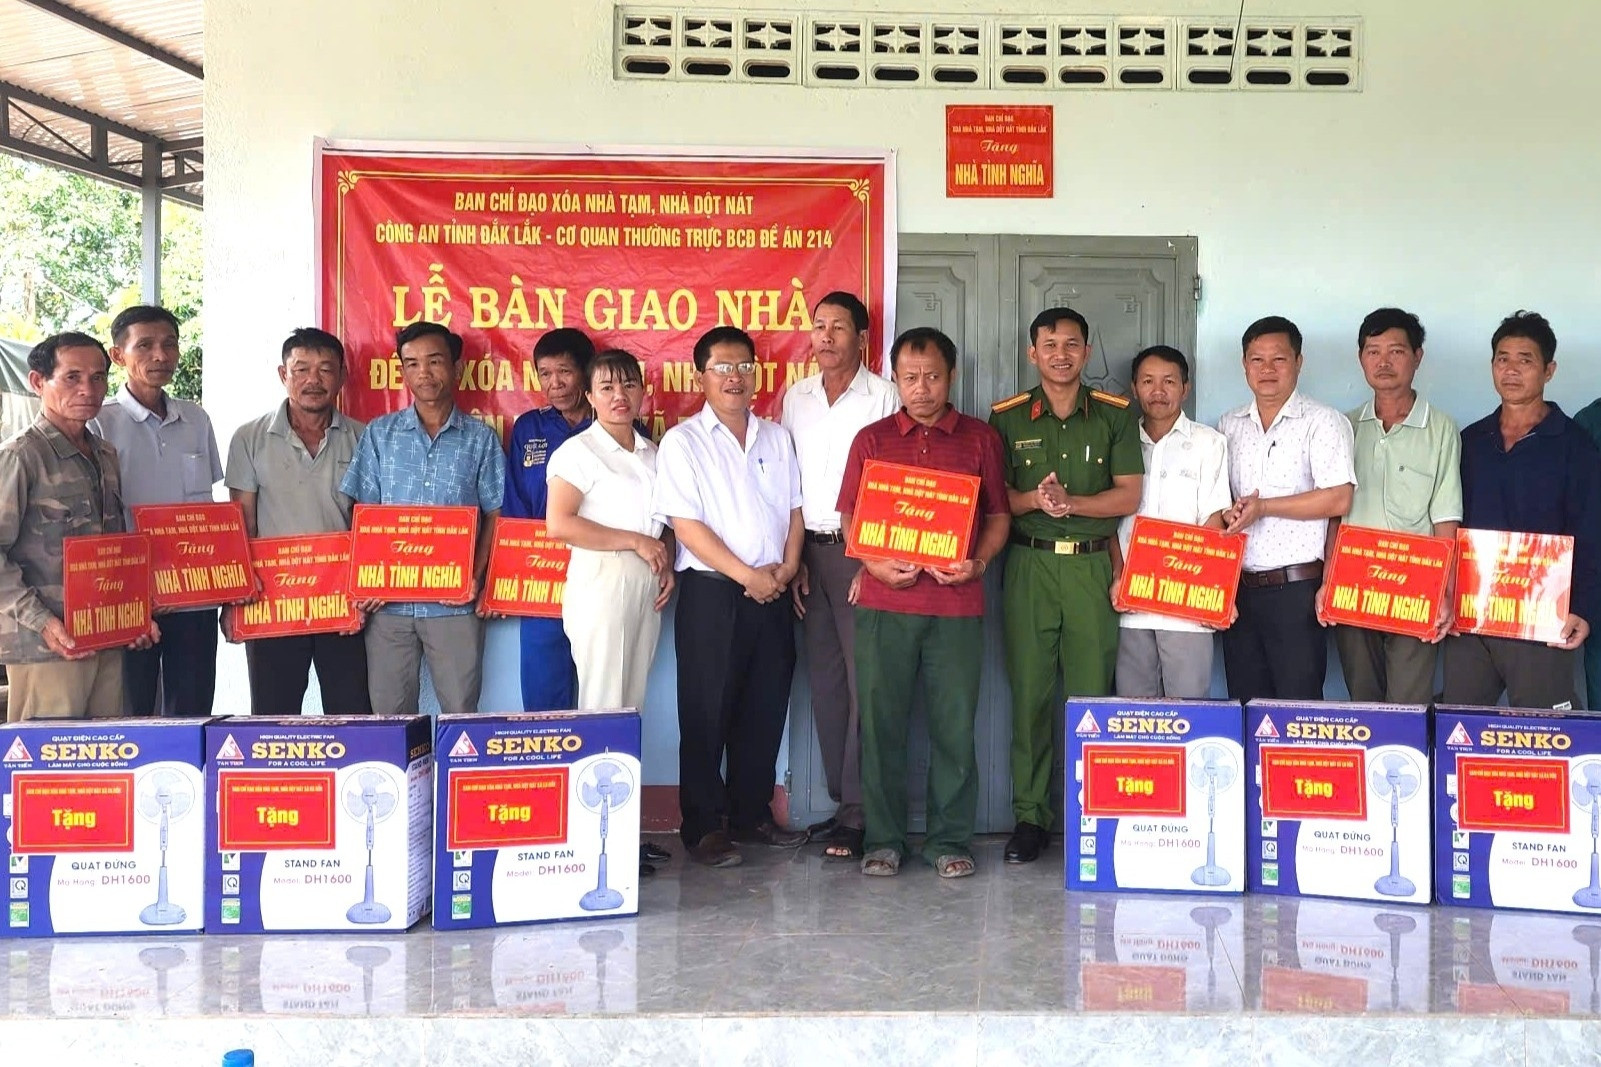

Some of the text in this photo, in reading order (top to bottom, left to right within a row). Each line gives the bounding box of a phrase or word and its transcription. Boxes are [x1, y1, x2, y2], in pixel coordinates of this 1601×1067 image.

[955, 159, 1044, 185] NHÀ TÌNH NGHĨA
[455, 187, 753, 218] BAN CHỈ ĐẠO XÓA NHÀ TẠM, NHÀ DỘT NÁT
[376, 219, 413, 243] CÔNG
[418, 224, 439, 243] AN
[443, 218, 476, 244] TỈNH
[480, 217, 510, 245] ĐẮK
[514, 218, 542, 245] LẮK
[556, 225, 577, 246] CƠ
[580, 225, 619, 247] QUAN
[624, 223, 680, 247] THƯỜNG
[685, 227, 722, 252] TRỰC
[727, 229, 756, 248] BCĐ
[760, 223, 778, 248] ĐỀ
[783, 227, 803, 248] ÁN
[807, 229, 832, 248] 214
[393, 263, 813, 331] LỄ BÀN GIAO NHÀ
[458, 353, 514, 392] XÓA
[663, 361, 704, 392] NH
[894, 500, 936, 521] Tặng
[176, 541, 215, 556] Tặng
[390, 540, 434, 556] Tặng
[858, 519, 958, 559] NHÀ TÌNH NGHĨA
[525, 554, 565, 572] Tặng
[1162, 555, 1202, 575] Tặng
[154, 564, 182, 595] NHÀ
[182, 564, 211, 592] TÌNH
[212, 560, 247, 589] NGHĨA
[274, 572, 318, 588] Tặng
[357, 561, 385, 588] NHÀ
[390, 561, 419, 588] TÌNH
[422, 561, 462, 589] NGHĨA
[1368, 565, 1408, 585] Tặng
[493, 574, 518, 600] NHÀ
[522, 575, 549, 603] TÌNH
[1128, 572, 1225, 613] NHÀ TÌNH NGHĨA
[244, 590, 349, 625] NHÀ TÌNH NGHĨA
[1332, 583, 1430, 624] NHÀ TÌNH NGHĨA
[73, 597, 145, 637] NHÀ TÌNH NGHĨA
[1107, 717, 1190, 734] SENKO
[1286, 723, 1371, 741] SENKO
[486, 735, 581, 755] SENKO
[1481, 731, 1571, 749] SENKO
[40, 743, 139, 760] SENKO
[252, 742, 345, 758] SENKO
[1116, 776, 1154, 796] Tặng
[1295, 779, 1333, 798] Tặng
[1493, 791, 1534, 810] Tặng
[52, 809, 96, 830] Tặng
[257, 807, 299, 827] Tặng
[488, 804, 531, 824] Tặng
[1158, 839, 1201, 848] DH1600
[1314, 831, 1371, 841] QUẠT ĐỨNG
[518, 850, 574, 861] STAND FAN
[1341, 846, 1383, 856] DH1600
[1512, 842, 1566, 852] STAND FAN
[72, 859, 136, 872] QUẠT ĐỨNG
[285, 860, 317, 868] STAND
[539, 863, 585, 875] DH1600
[1532, 858, 1577, 868] DH1600
[102, 875, 151, 885] DH1600
[305, 874, 352, 884] DH1600
